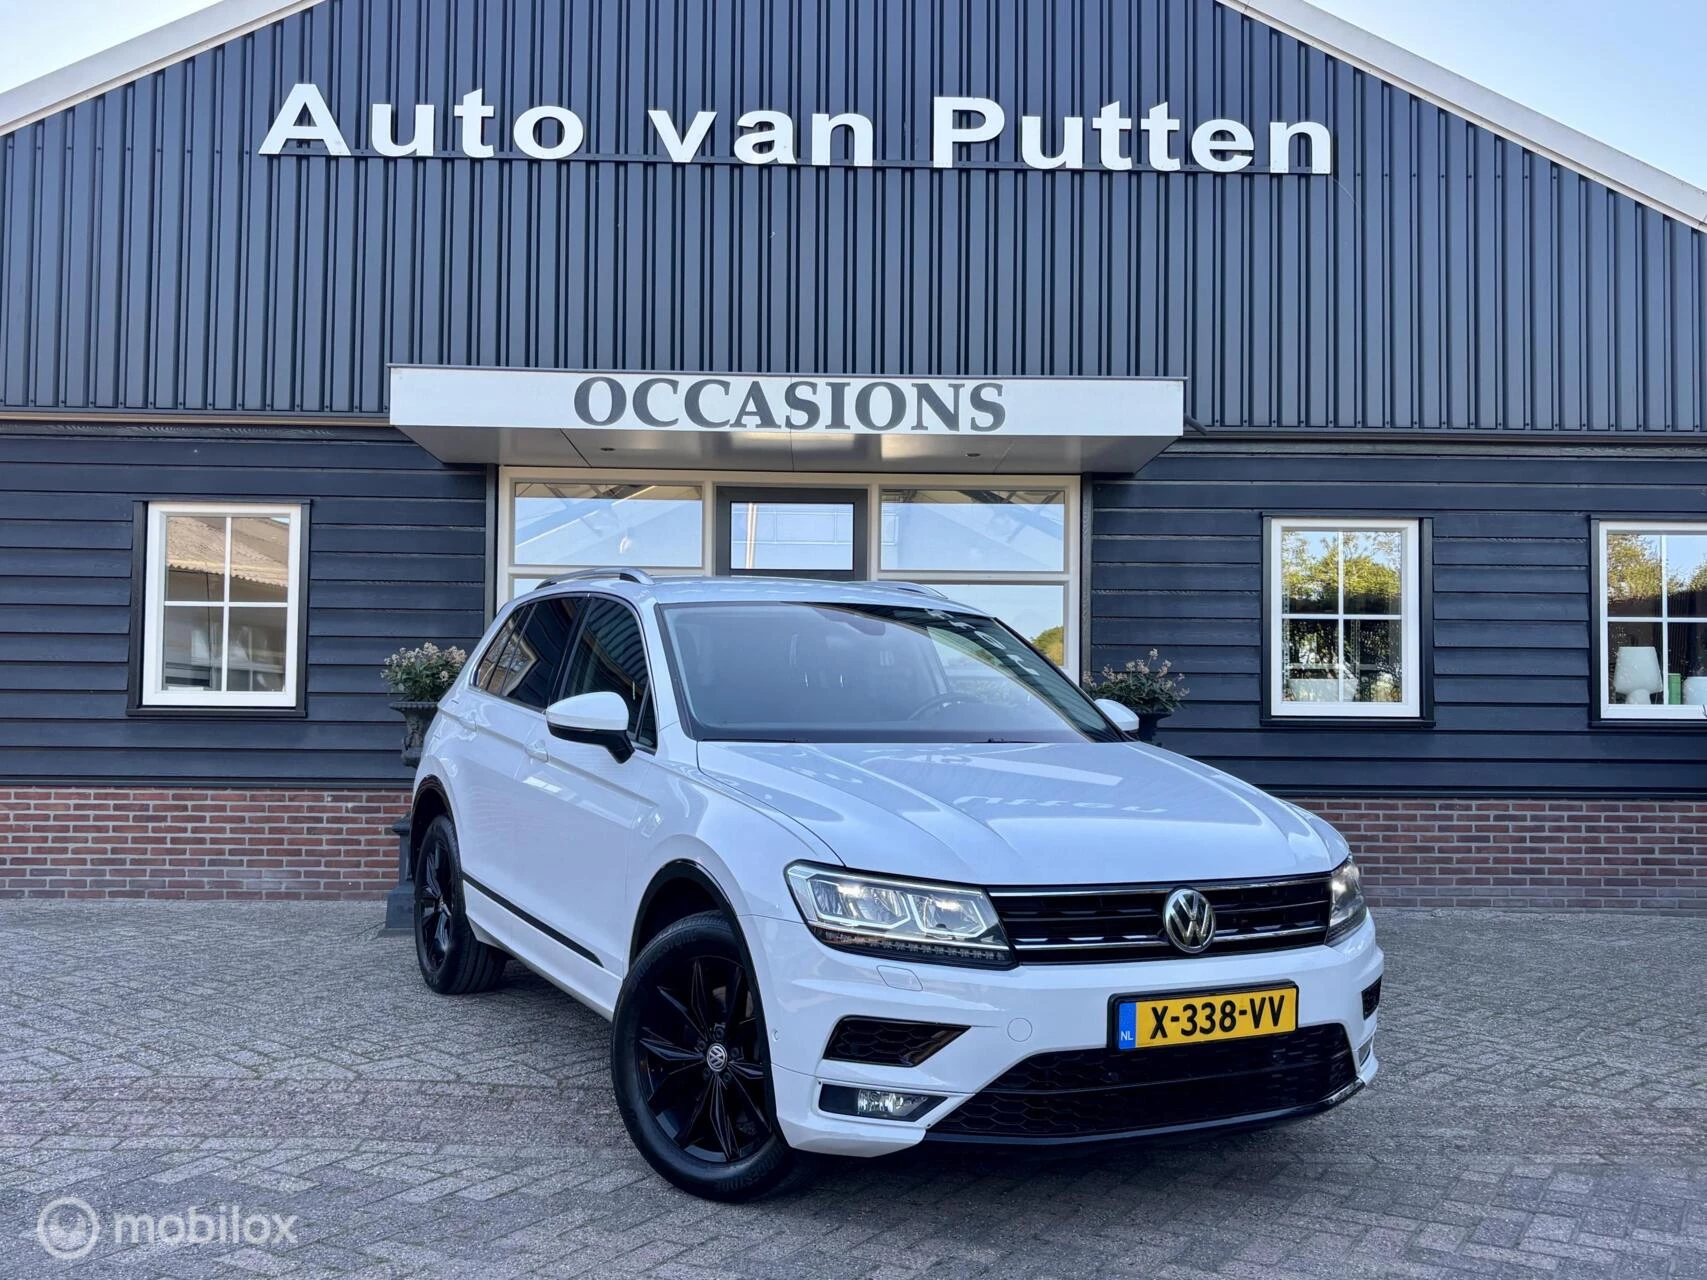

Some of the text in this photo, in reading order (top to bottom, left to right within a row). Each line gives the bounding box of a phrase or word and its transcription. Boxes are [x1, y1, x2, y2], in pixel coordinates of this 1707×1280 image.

[258, 83, 1332, 175] Auto van Putten
[573, 376, 1007, 432] OCCASIONS
[1120, 1030, 1134, 1041] NL
[1149, 995, 1286, 1040] X-338-VV
